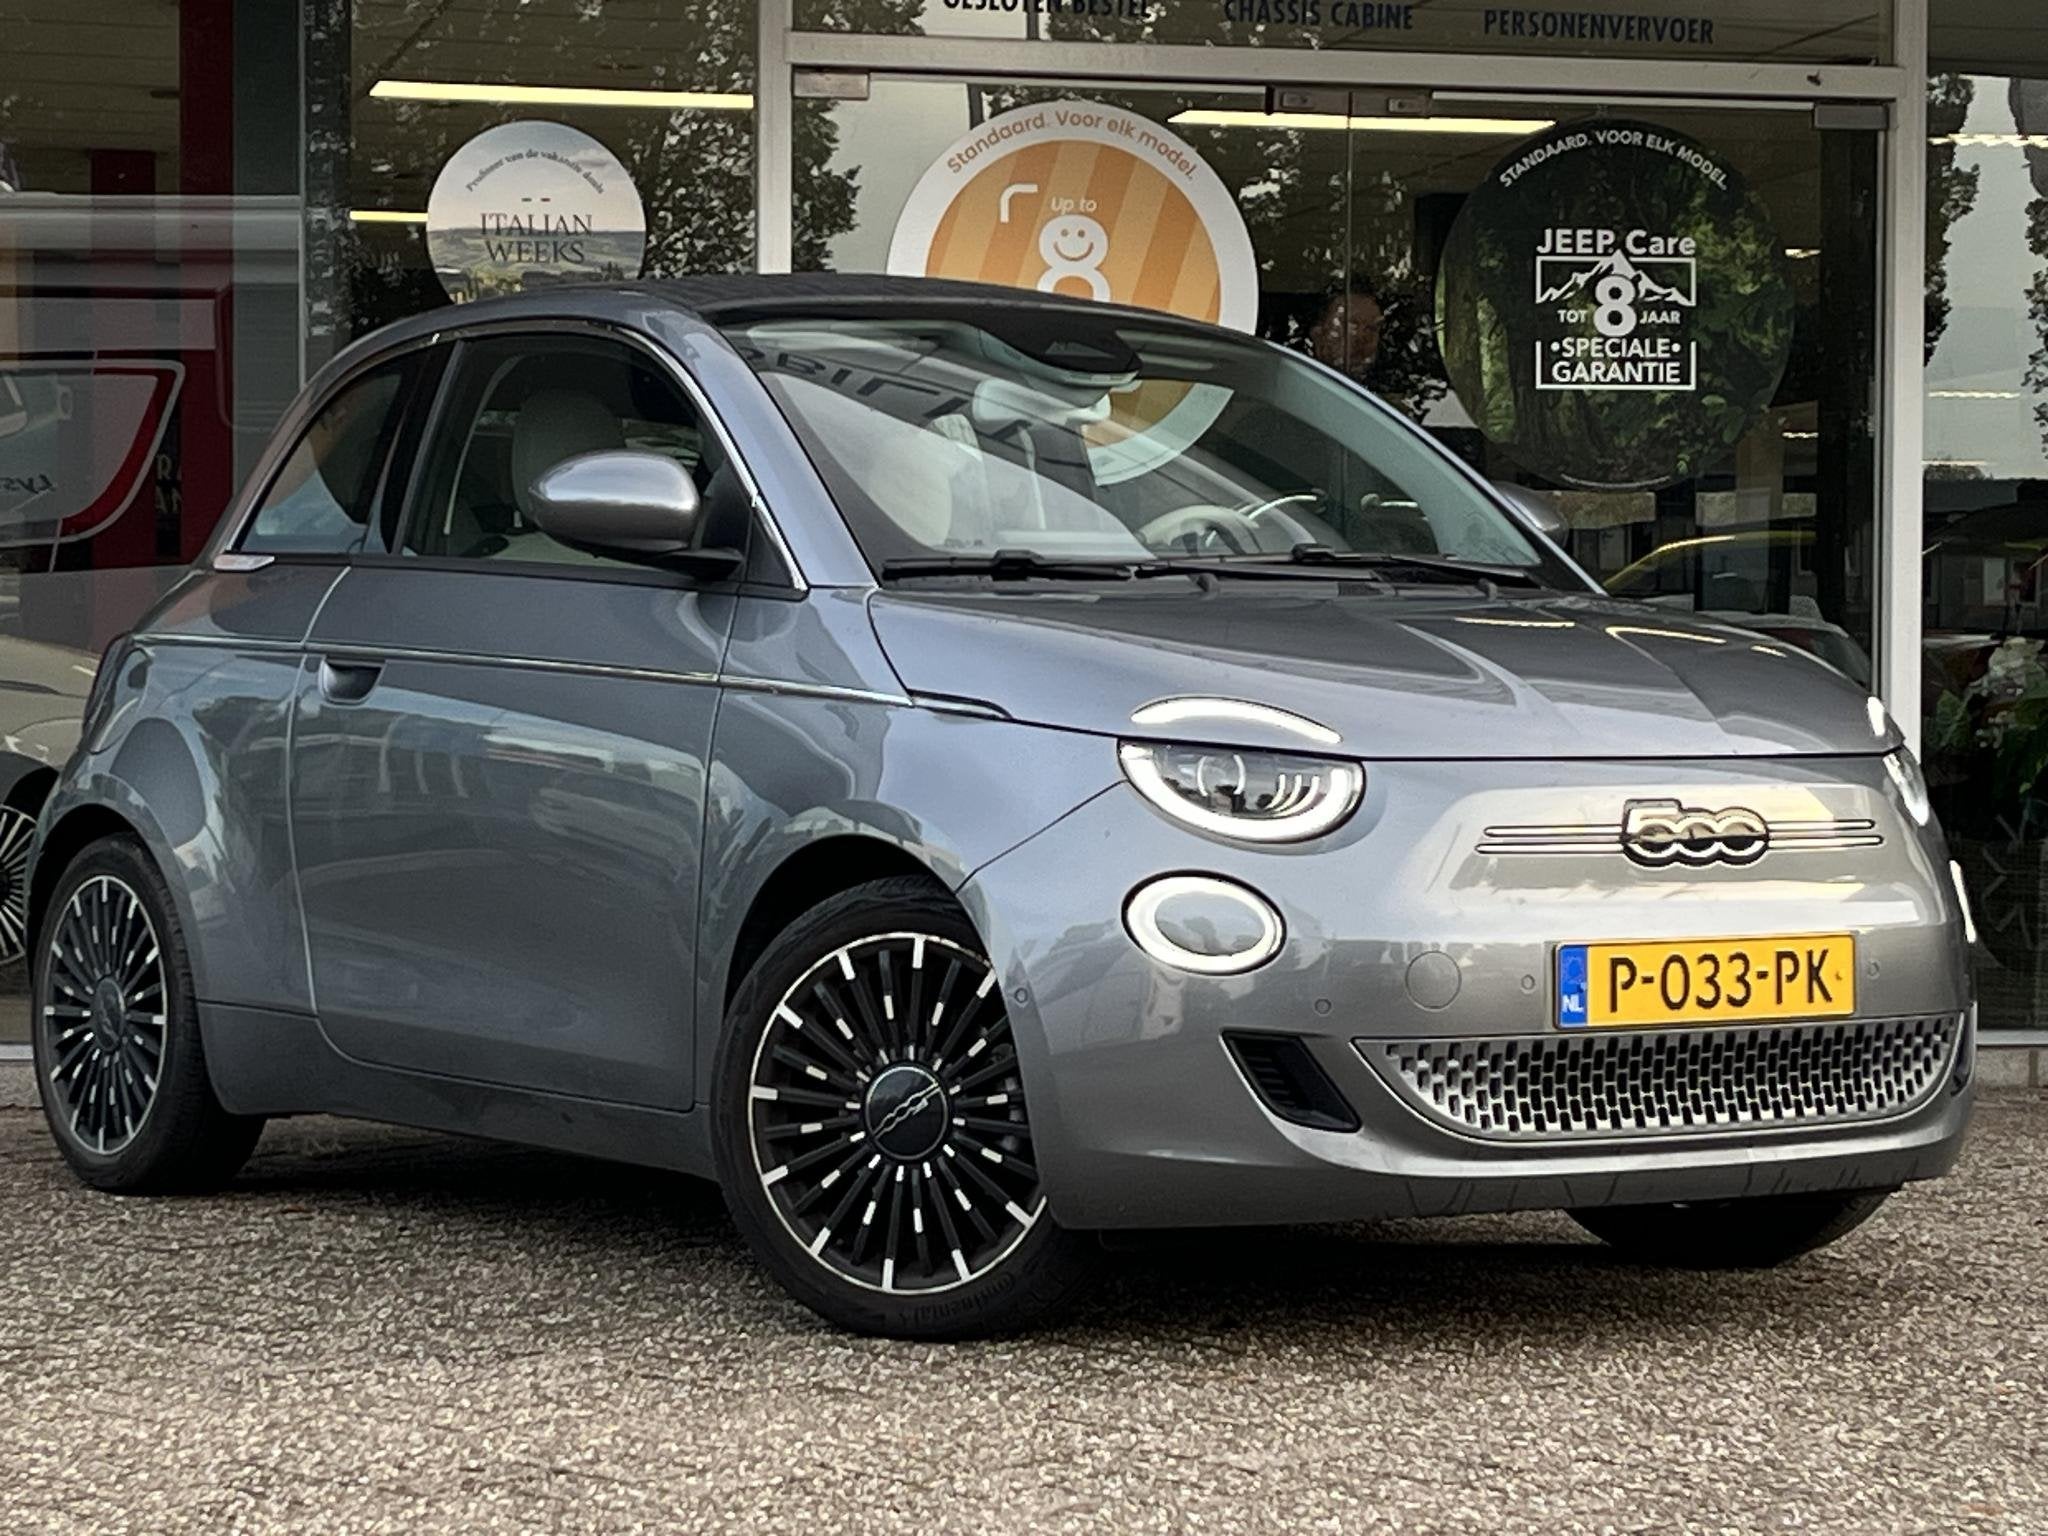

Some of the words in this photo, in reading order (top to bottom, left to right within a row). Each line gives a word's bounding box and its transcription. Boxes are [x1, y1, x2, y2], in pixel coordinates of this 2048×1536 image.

[1225, 0, 1321, 25] CHASSIS
[1331, 3, 1413, 29] CABINE
[1484, 9, 1713, 43] PERSONENVERVOER
[1055, 109, 1103, 128] Voor
[1106, 117, 1136, 139] elk
[1595, 129, 1643, 146] VOOR
[1645, 134, 1675, 156] ELK
[1051, 198, 1076, 215] Up
[1078, 197, 1098, 213] to
[480, 212, 593, 236] ITALIAN
[484, 240, 586, 264] WEEKS
[1625, 229, 1697, 255] Care
[1557, 309, 1586, 323] TOT
[1593, 274, 1637, 337] 8
[1639, 310, 1681, 325] JAAR
[1551, 361, 1681, 383] GARANTIE
[1622, 798, 1770, 867] 500
[1608, 948, 1833, 1013] P-033-PK
[1561, 993, 1584, 1014] NL
